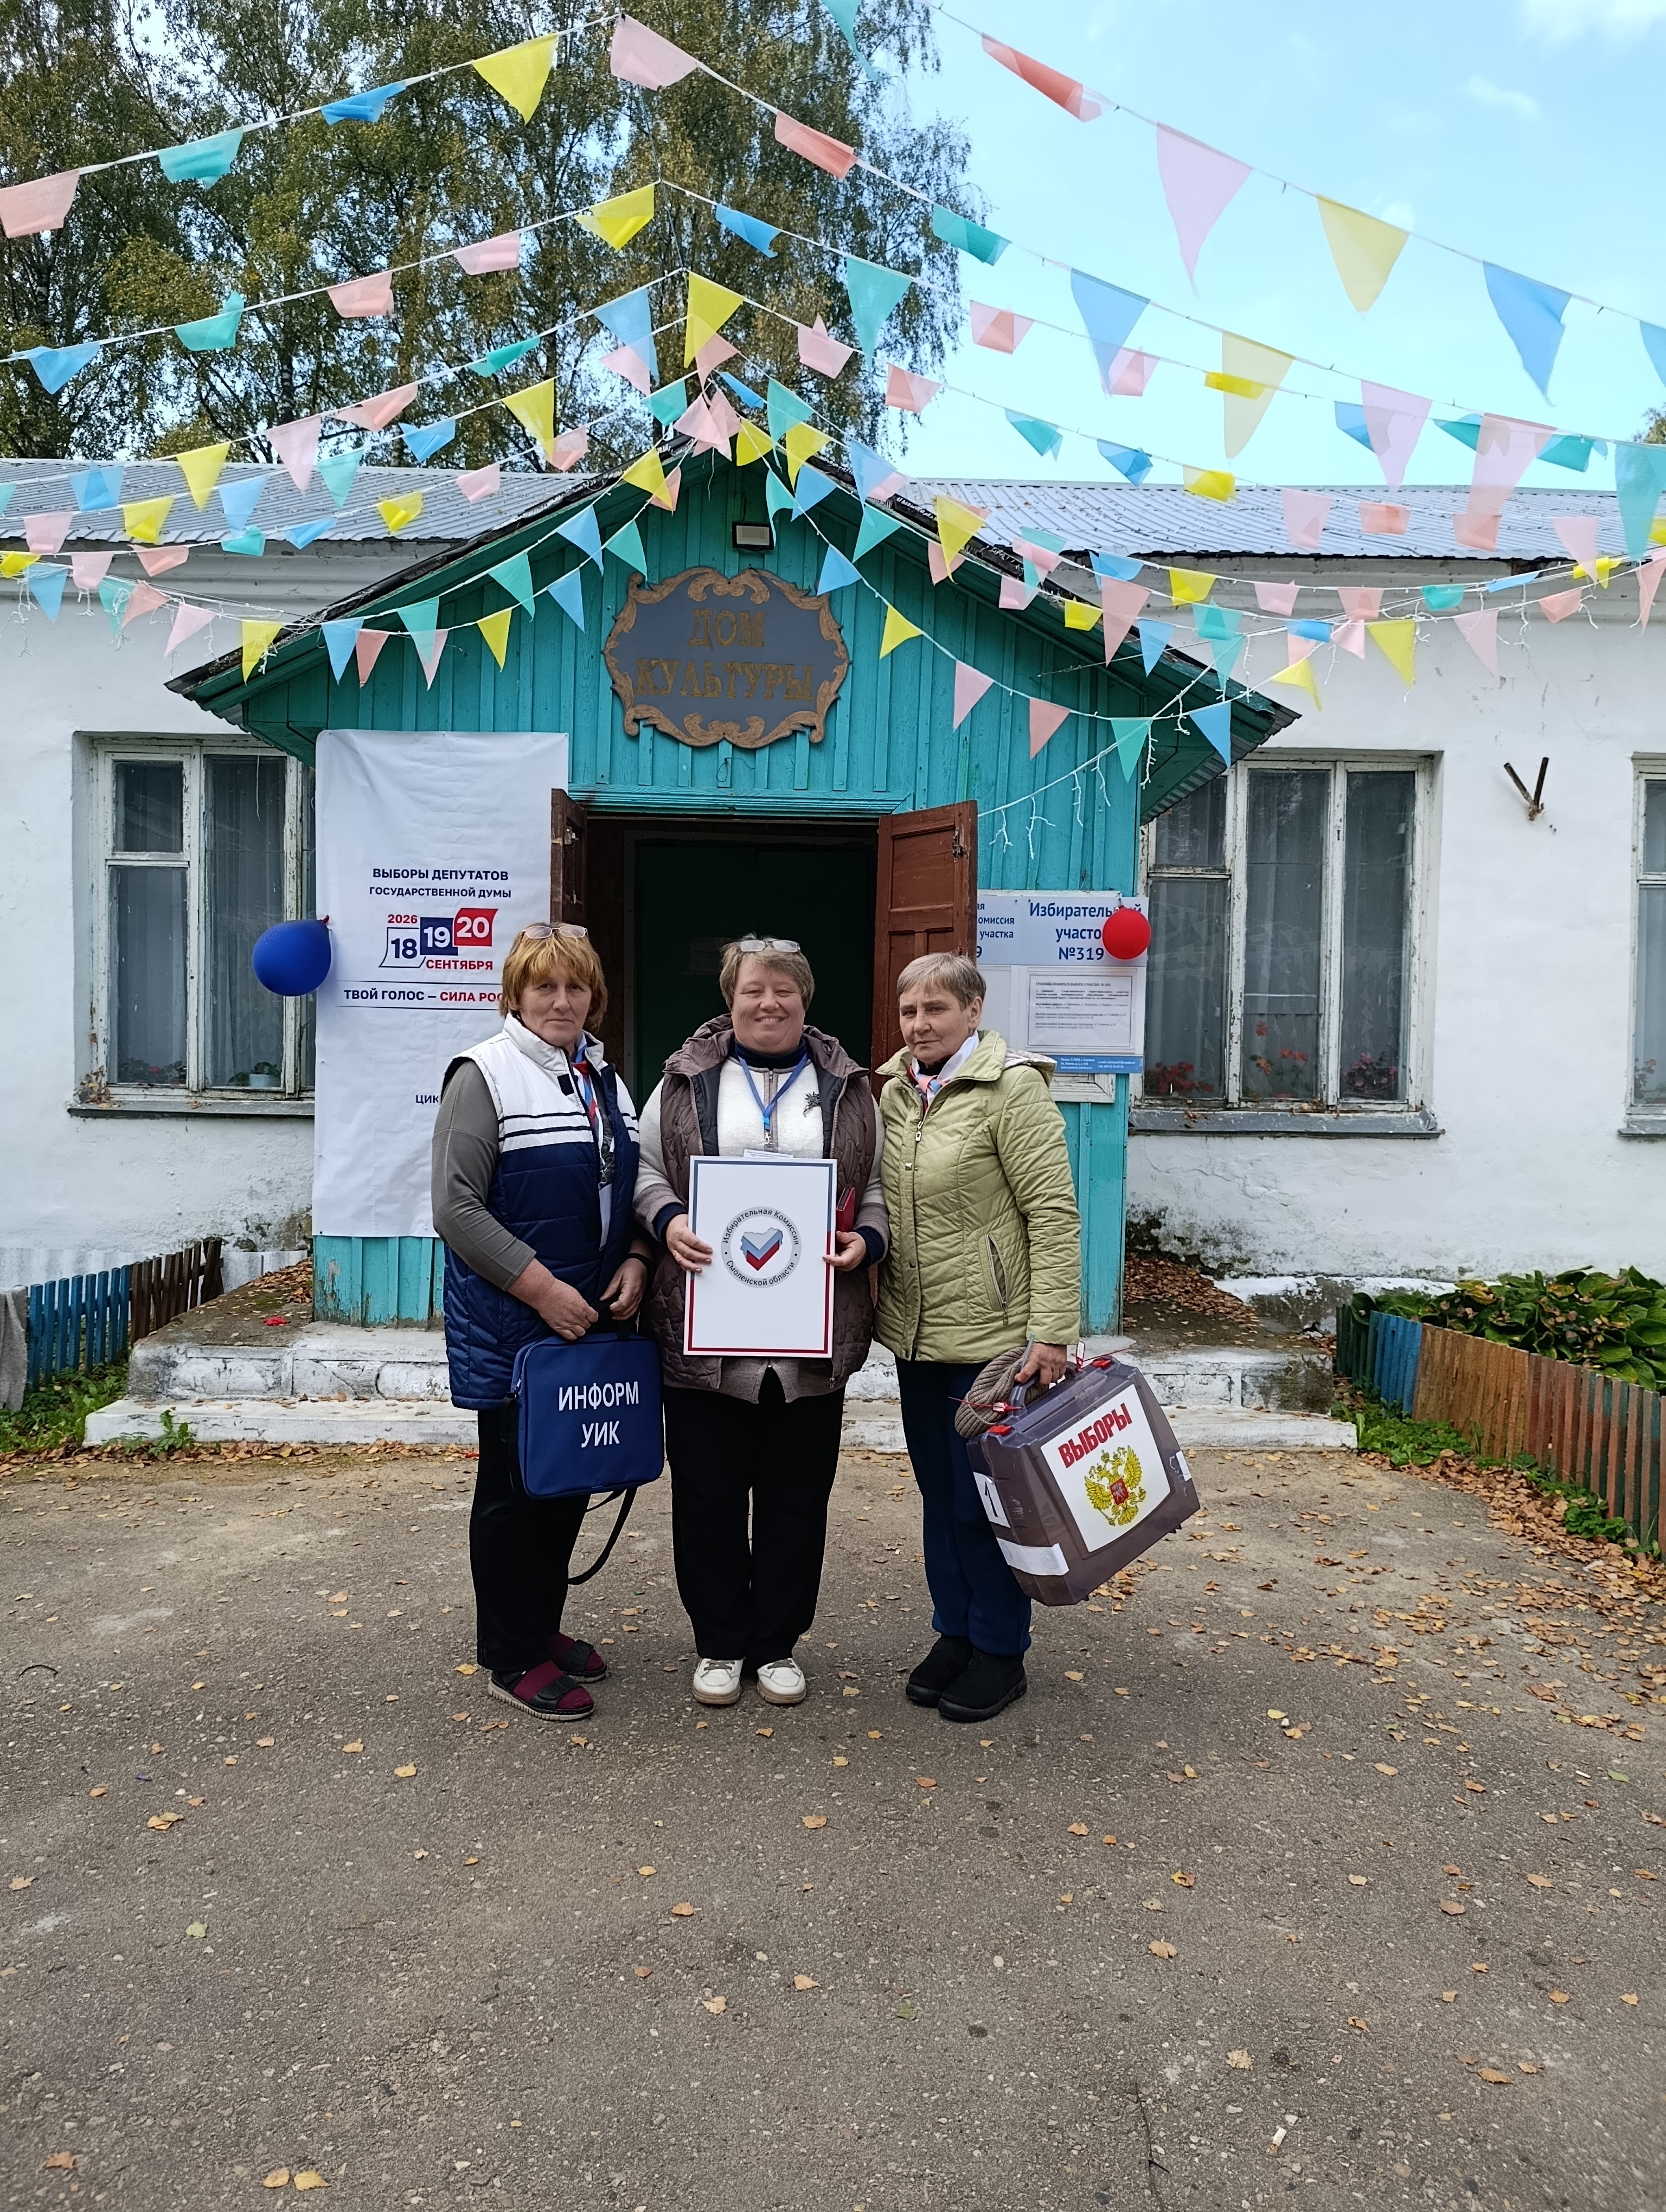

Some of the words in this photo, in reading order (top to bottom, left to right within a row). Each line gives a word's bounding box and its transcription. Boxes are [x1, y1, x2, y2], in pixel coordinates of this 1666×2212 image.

[688, 609, 765, 651] ДОМ
[635, 658, 814, 700] КУЛЬТУРЫ
[373, 869, 428, 879] ВЫБОРЫ
[432, 870, 509, 880] ДЕПУТАТОВ
[369, 886, 476, 897] ГОСУДАРСТВЕННОЙ
[478, 889, 511, 898] ДУМЫ
[388, 914, 418, 924] 2026
[1030, 902, 1142, 921] Избирательй
[391, 938, 417, 959] 18
[424, 927, 451, 948] 19
[457, 917, 490, 938] 20
[979, 931, 1014, 940] участка
[1055, 928, 1101, 942] участо
[1059, 947, 1104, 960] №319
[426, 960, 493, 970] СЕНТЯБРЯ
[344, 988, 378, 1000] ТВОЙ
[382, 991, 424, 1000] ГОЛОС
[440, 992, 476, 1001] СИЛА
[416, 1095, 438, 1104] ЦИК
[723, 1209, 772, 1244] Избирательная
[774, 1211, 799, 1245] Комиссия
[727, 1261, 767, 1285] Смоленской
[769, 1262, 794, 1284] области
[559, 1381, 639, 1411] ИНФОРМ
[581, 1420, 620, 1448] УИК
[1058, 1403, 1132, 1468] ВЫБОРЫ
[984, 1481, 998, 1518] 1
